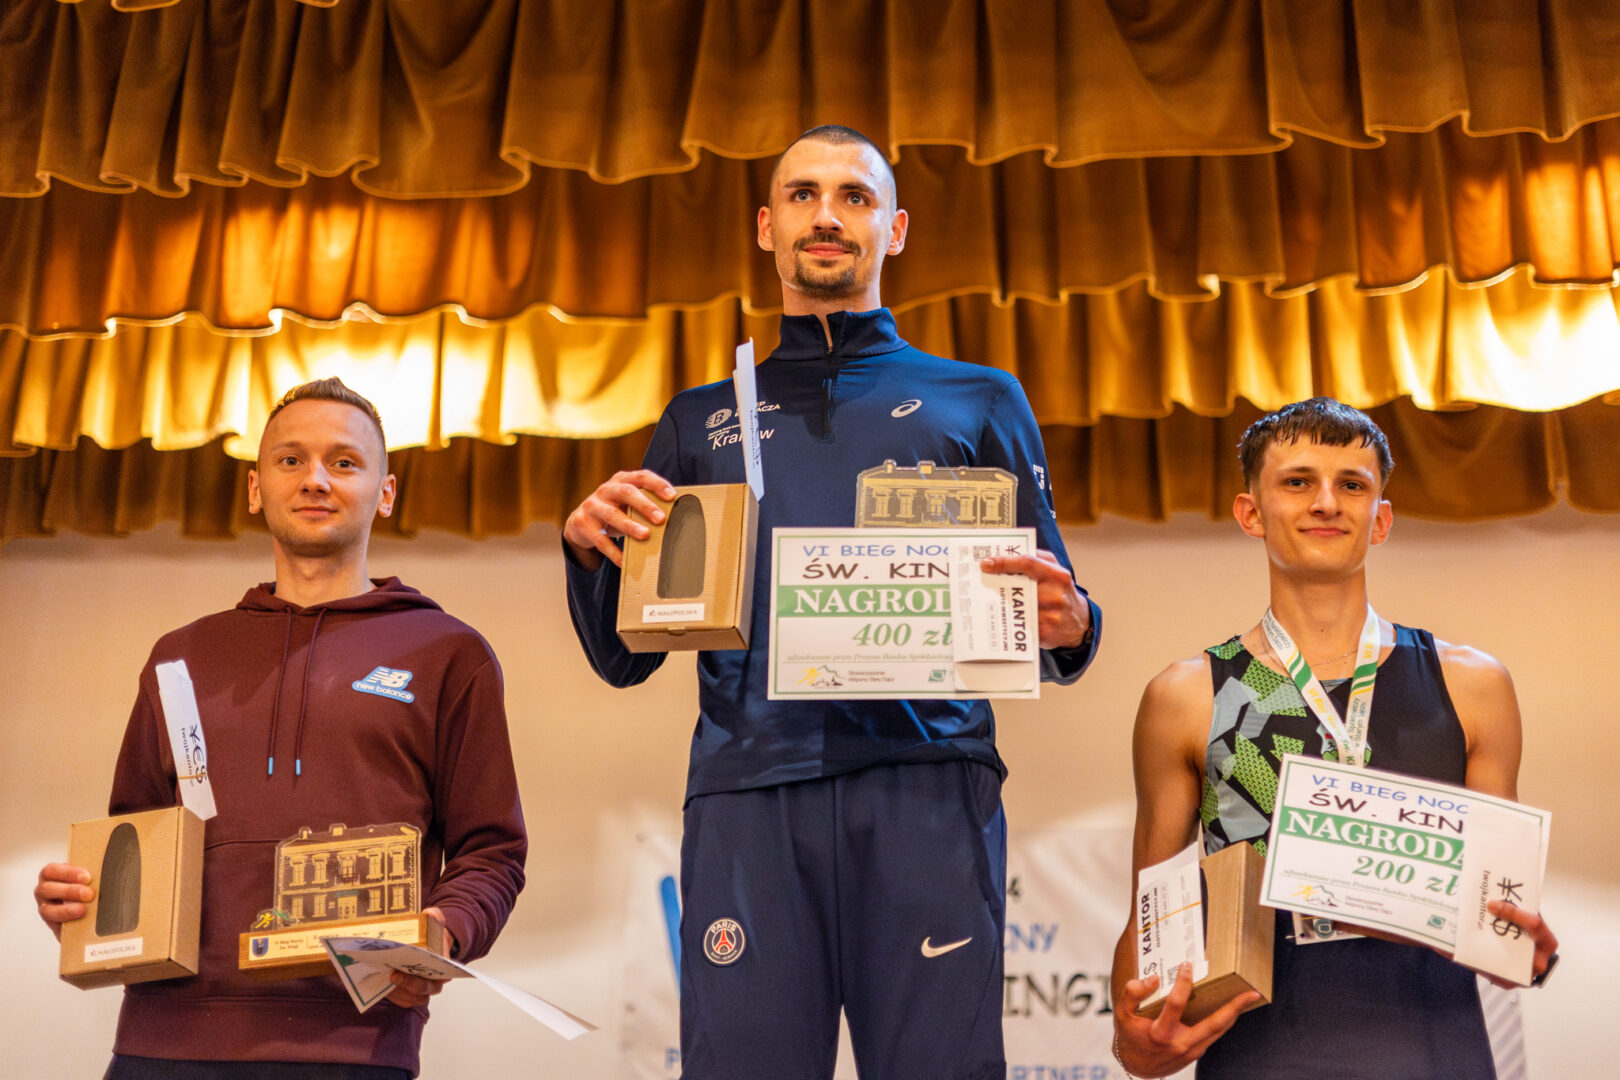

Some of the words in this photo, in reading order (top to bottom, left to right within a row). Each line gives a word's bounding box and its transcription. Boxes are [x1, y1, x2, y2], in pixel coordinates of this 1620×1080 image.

[712, 428, 775, 450] Kraw
[803, 545, 829, 557] VI
[840, 545, 896, 557] BIEG
[793, 588, 952, 614] NAGROD
[1011, 587, 1027, 652] KANTOR
[853, 623, 912, 647] 400
[356, 682, 375, 691] new
[376, 685, 412, 700] balance
[1311, 774, 1340, 790] VI
[1350, 781, 1408, 802] BIEG
[1418, 794, 1469, 815] NOC
[1398, 807, 1464, 834] KIN
[1352, 855, 1415, 885] 200
[1425, 873, 1459, 897] zł
[710, 921, 737, 934] PARIS
[1141, 893, 1152, 956] KANTOR
